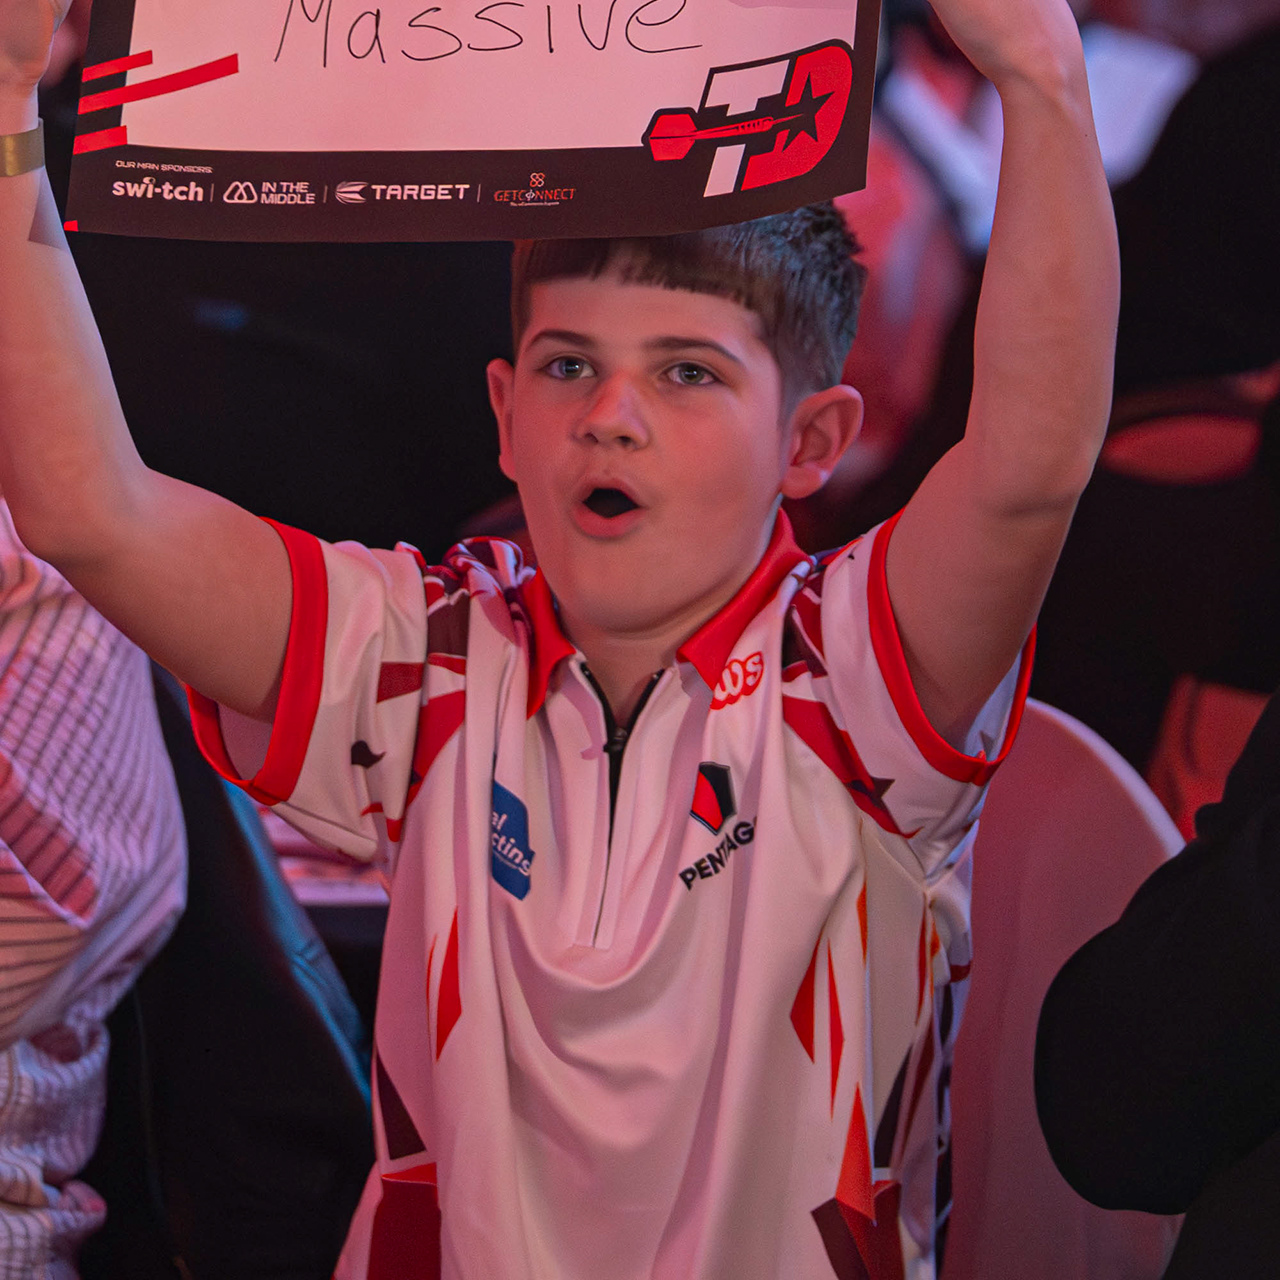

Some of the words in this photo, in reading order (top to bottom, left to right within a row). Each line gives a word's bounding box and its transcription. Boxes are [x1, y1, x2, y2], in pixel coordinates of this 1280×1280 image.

[115, 160, 136, 169] OUR
[261, 181, 277, 193] IN
[279, 182, 310, 194] THE
[371, 183, 470, 200] TARGET
[260, 193, 316, 205] MIDDLE
[678, 818, 757, 892] PENTAG
